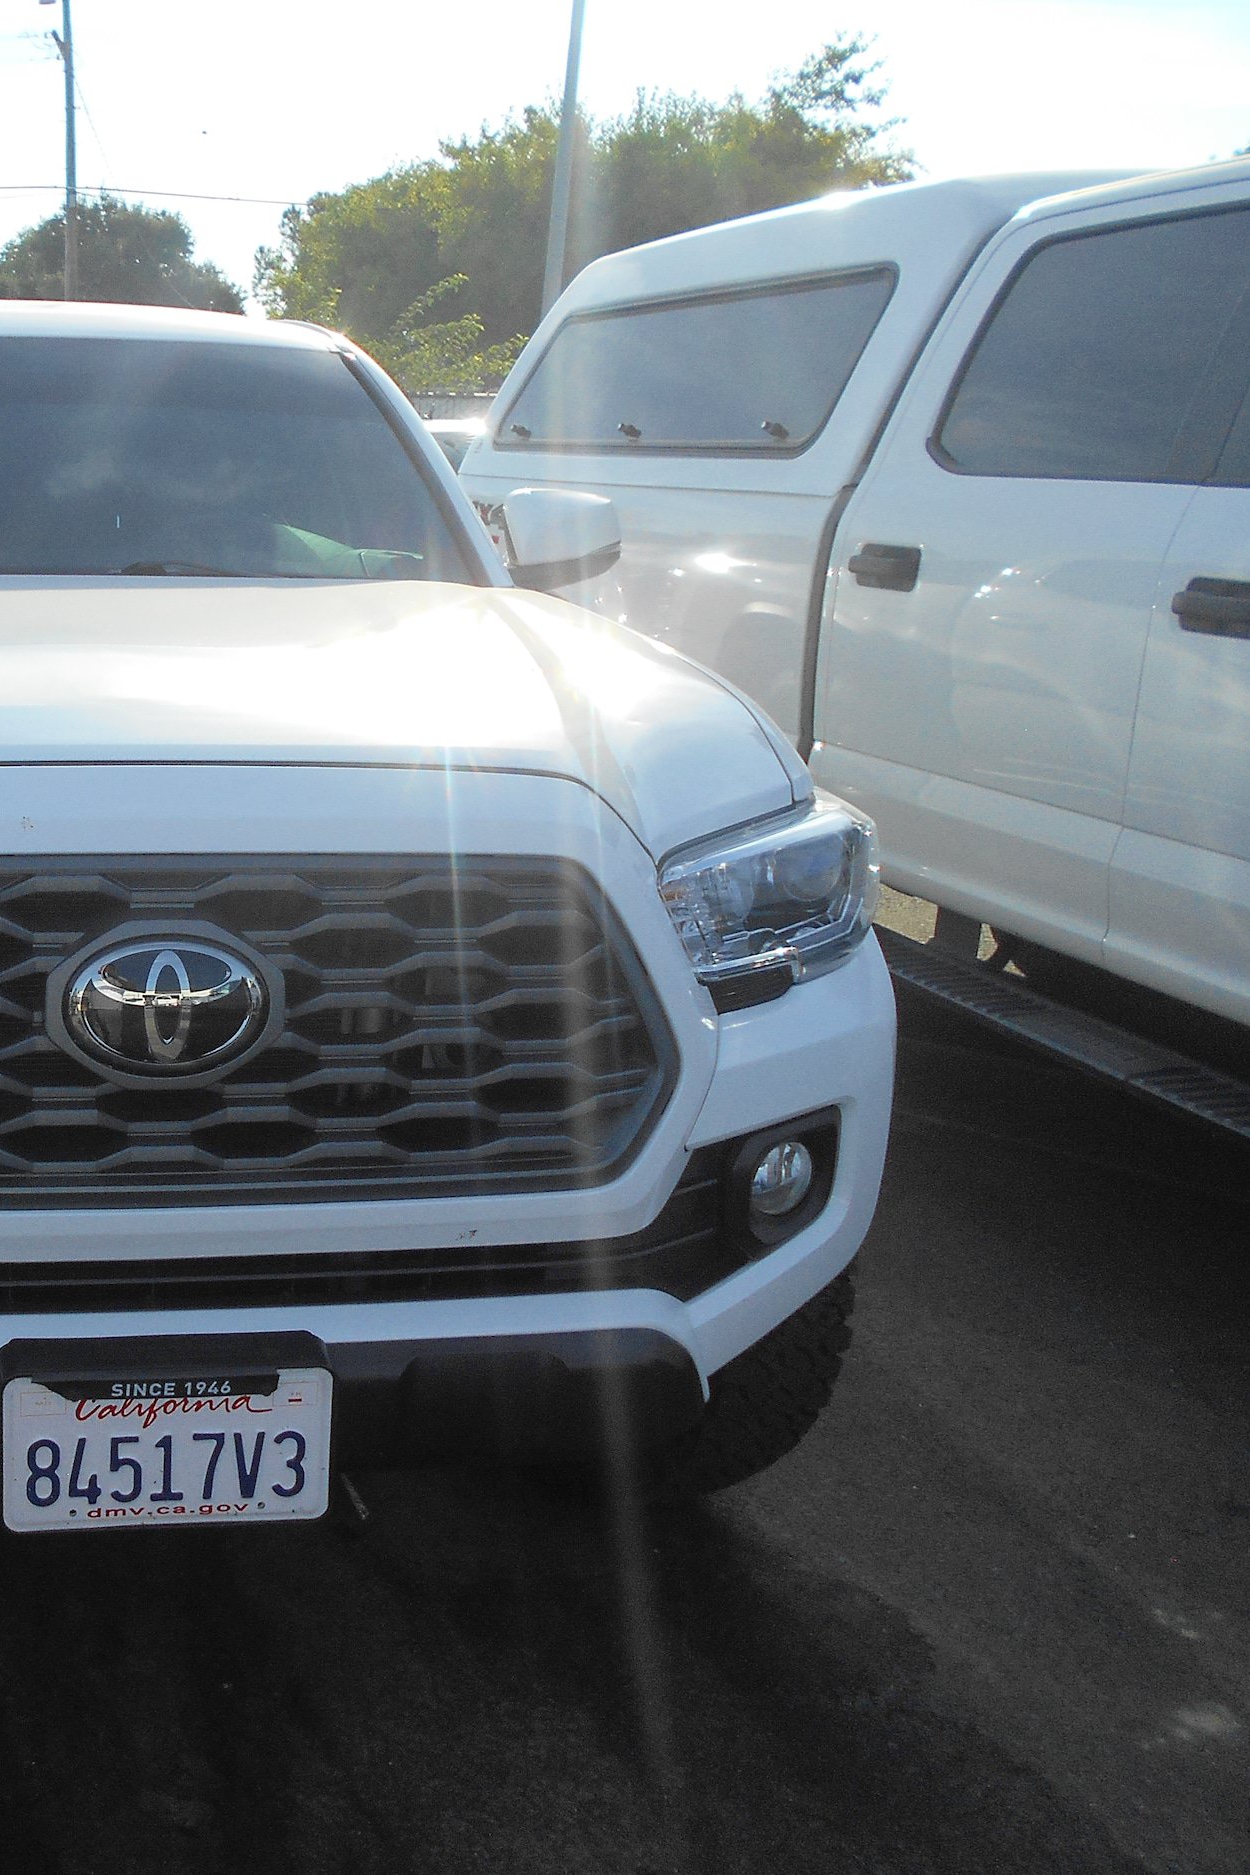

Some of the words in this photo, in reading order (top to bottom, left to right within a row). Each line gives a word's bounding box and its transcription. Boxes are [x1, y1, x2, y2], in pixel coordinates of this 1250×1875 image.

[110, 1383, 175, 1398] SINCE
[184, 1381, 232, 1395] 1946
[75, 1394, 273, 1429] California
[26, 1430, 306, 1507] 84517V3
[87, 1502, 249, 1518] dmv.ca.gov
